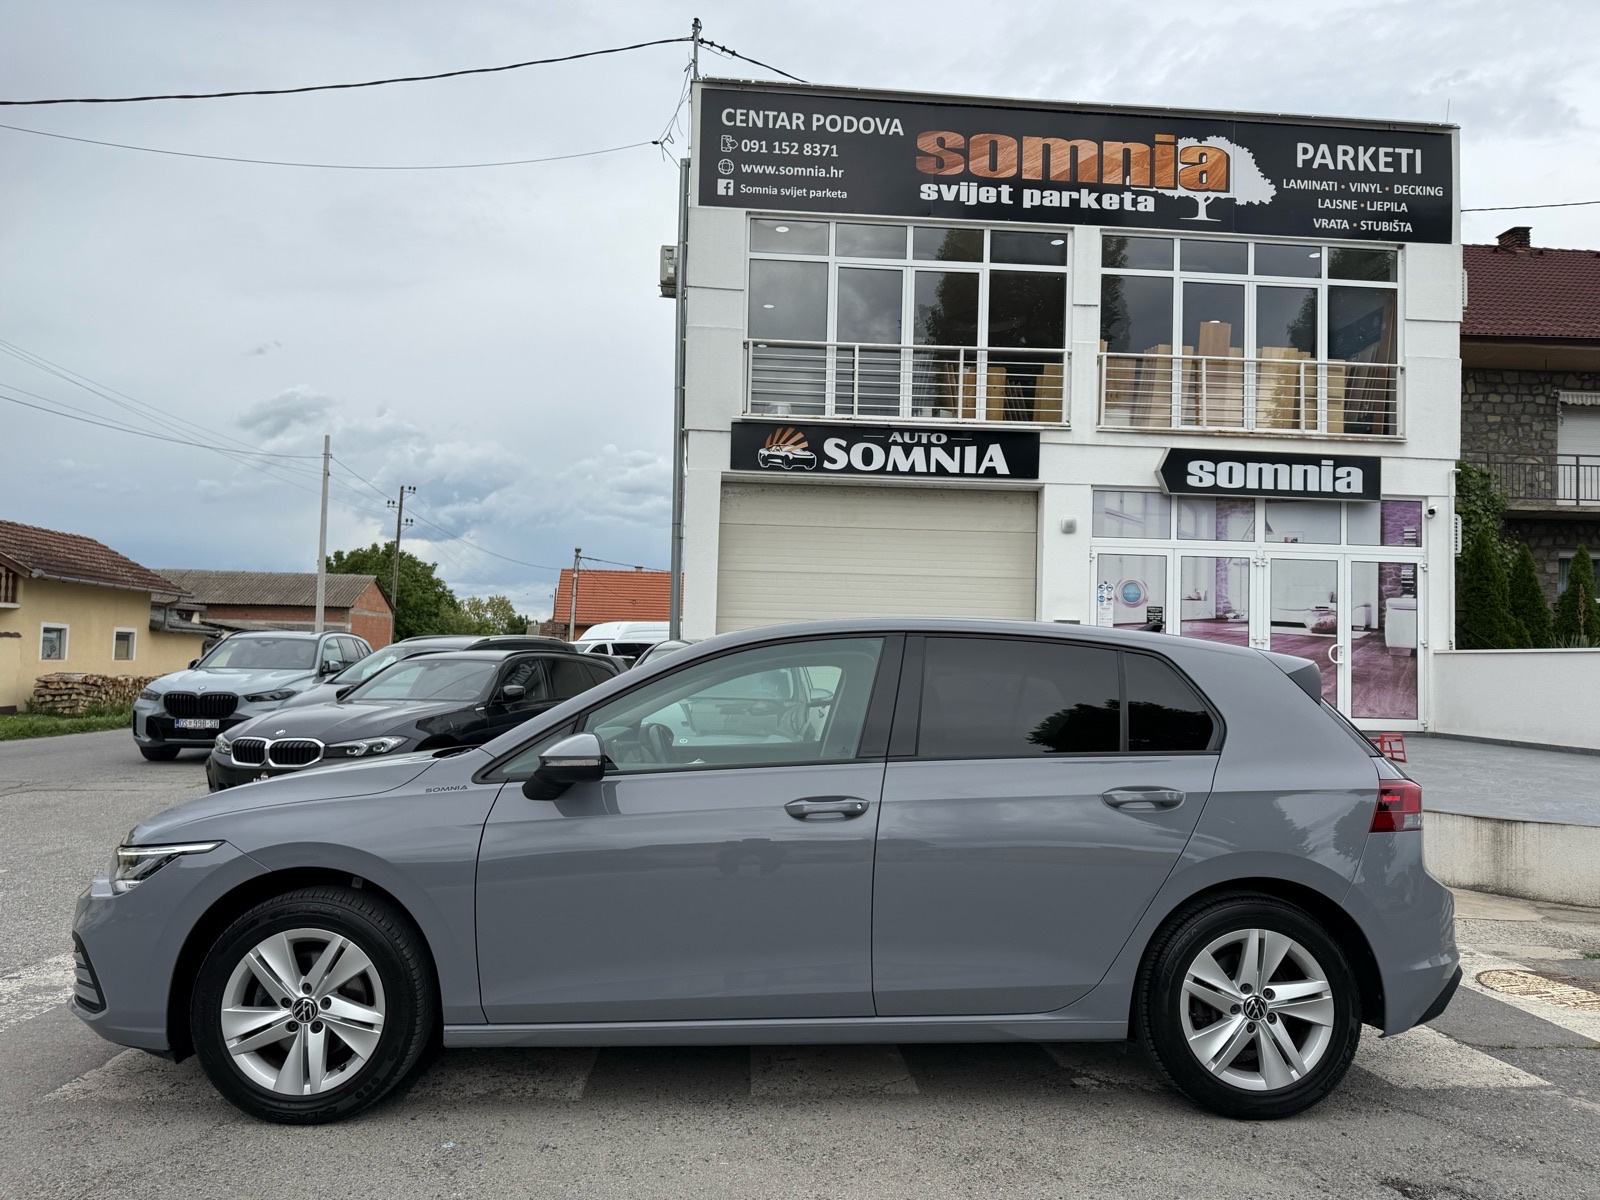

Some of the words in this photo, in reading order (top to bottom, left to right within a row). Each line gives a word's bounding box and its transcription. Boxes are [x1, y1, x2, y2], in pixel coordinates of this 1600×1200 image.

[721, 108, 805, 131] CENTAR
[812, 113, 904, 136] PODOVA
[741, 139, 768, 153] 091
[772, 141, 799, 155] 152
[803, 143, 839, 157] 8371
[915, 130, 1228, 192] somnia
[1296, 142, 1422, 174] PARKETI
[741, 164, 844, 178] www.somnia.hr
[740, 184, 778, 195] Somnia
[780, 186, 807, 198] svijet
[809, 188, 848, 199] parketa
[1283, 179, 1338, 191] LAMINATI
[1349, 182, 1383, 193] VINYL
[1394, 185, 1444, 196] DECKING
[920, 182, 1013, 205] svijet
[1022, 187, 1155, 212] parketa
[1318, 198, 1358, 210] LAJSNE
[1366, 201, 1408, 212] LJEPILA
[1313, 218, 1350, 230] VRATA
[1360, 219, 1413, 232] STUBIŠTA
[888, 431, 948, 444] AUTO
[823, 437, 1010, 475] SOMNIA
[1186, 459, 1364, 494] somnia
[425, 784, 468, 793] SOMNIA
